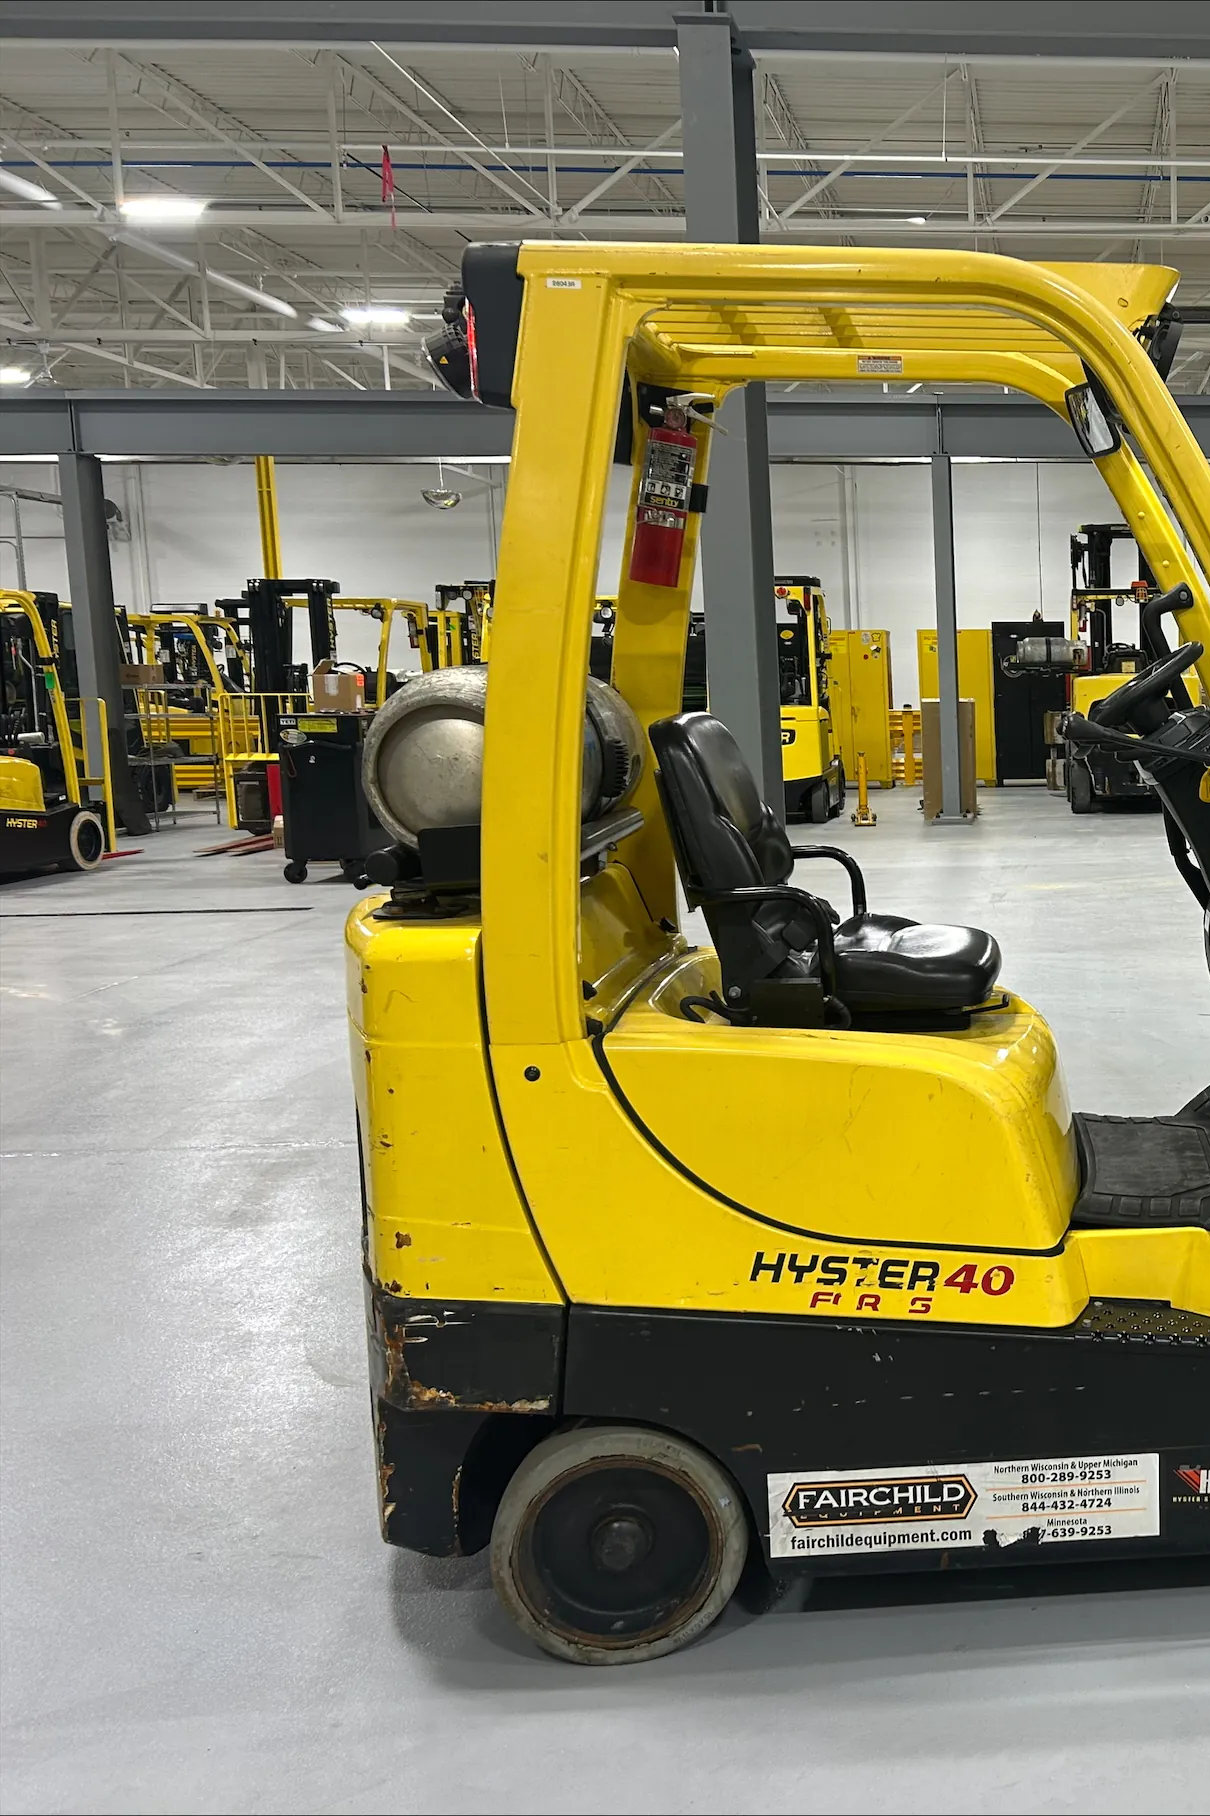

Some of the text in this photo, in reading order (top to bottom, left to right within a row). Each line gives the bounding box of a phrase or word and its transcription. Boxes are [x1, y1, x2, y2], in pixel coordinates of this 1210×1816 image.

[650, 495, 679, 508] sentry
[6, 817, 38, 829] HYSTER
[750, 1251, 1015, 1296] HYSTER 40
[993, 1458, 1138, 1474] Northern Wisconsin & Upper Michigan
[1021, 1469, 1112, 1484] 800-289-9253
[798, 1483, 966, 1510] FAIRCHILD
[992, 1485, 1140, 1502] Southern Wisconsin & Northern Illinois
[1172, 1495, 1201, 1503] HYSTER
[1021, 1497, 1112, 1512] 844-432-4724
[1046, 1518, 1088, 1528] Minnesota
[790, 1529, 972, 1550] fairchildequipment.com
